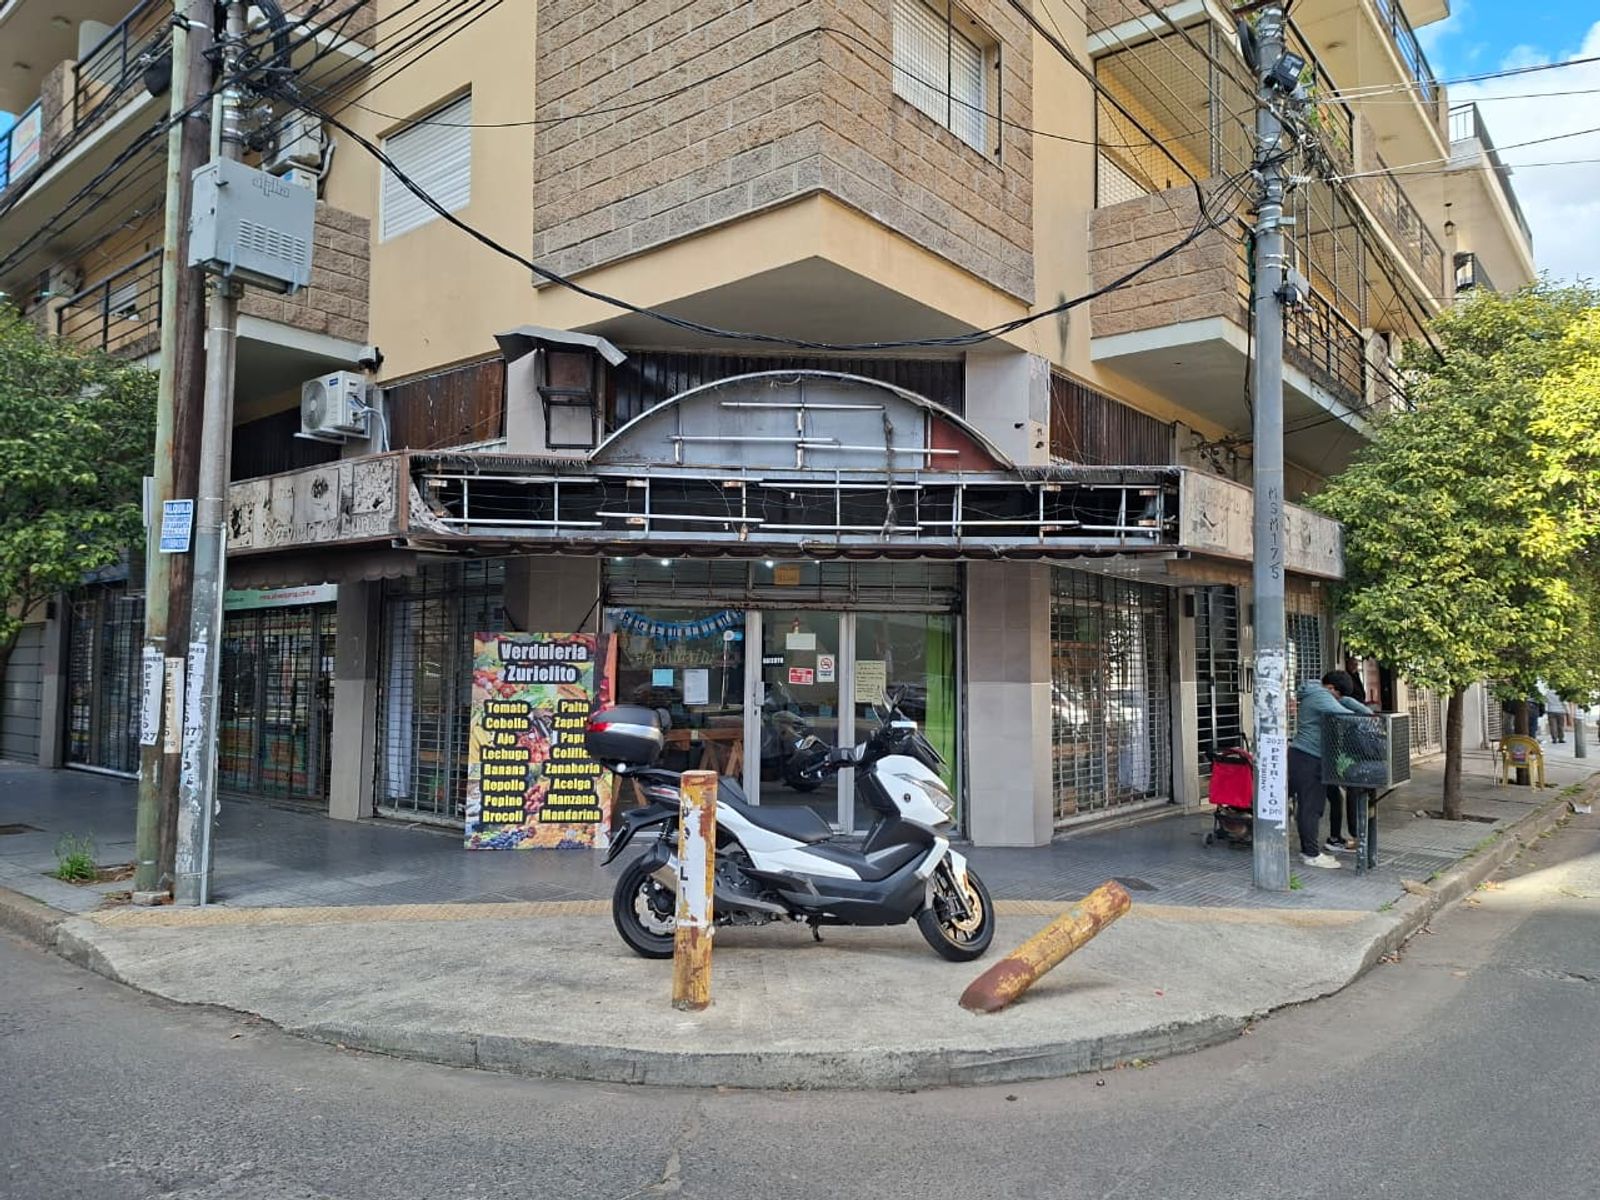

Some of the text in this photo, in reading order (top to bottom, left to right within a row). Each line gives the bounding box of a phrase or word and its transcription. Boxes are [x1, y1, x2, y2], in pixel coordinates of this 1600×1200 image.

[561, 702, 589, 713] Palta
[486, 718, 529, 729] Cebolla
[554, 716, 588, 729] Zapal
[144, 733, 157, 741] 27
[497, 732, 516, 745] Ajo
[483, 748, 529, 760] Lechuga
[484, 763, 526, 775] Banana
[545, 762, 600, 774] Zanahoria
[483, 779, 525, 791] Repollo
[553, 778, 592, 791] Acelga
[484, 795, 523, 807] Pepino
[548, 794, 596, 805] Manzana
[542, 809, 600, 821] Mandarina
